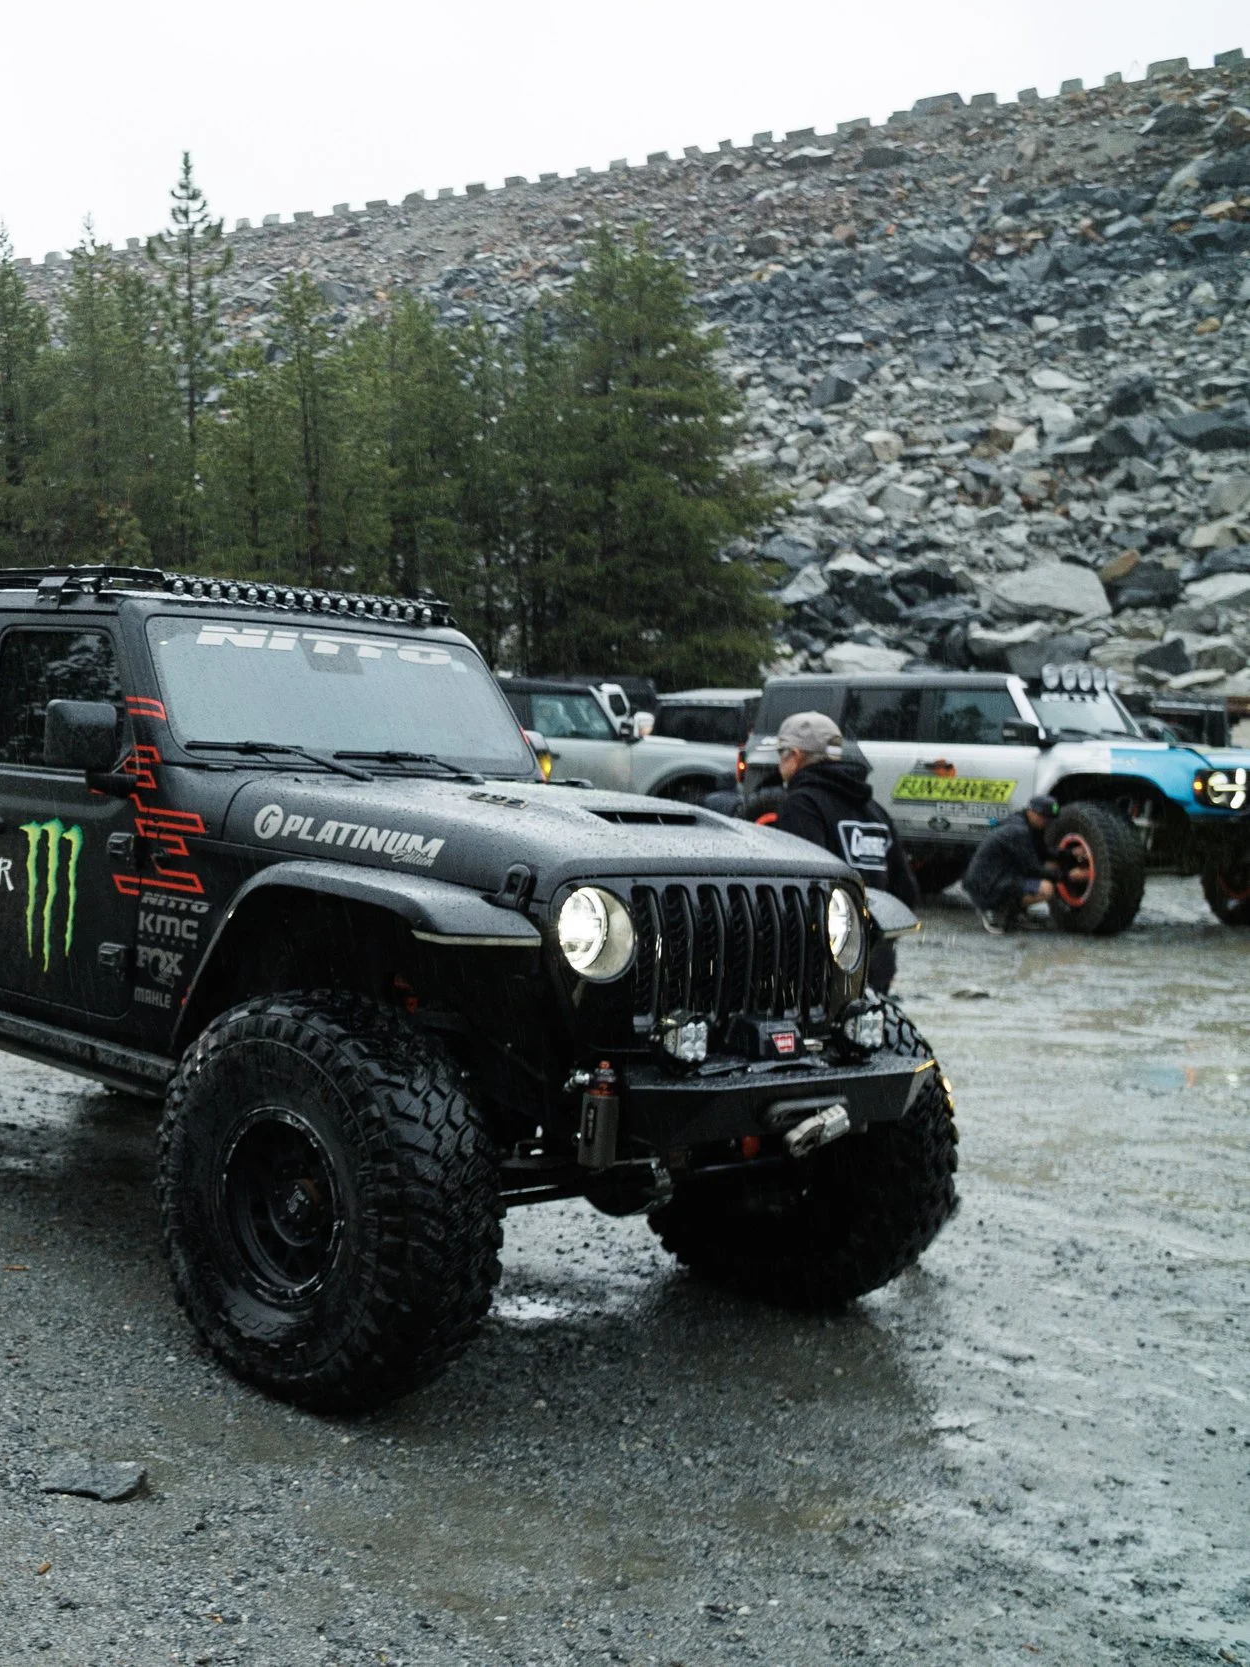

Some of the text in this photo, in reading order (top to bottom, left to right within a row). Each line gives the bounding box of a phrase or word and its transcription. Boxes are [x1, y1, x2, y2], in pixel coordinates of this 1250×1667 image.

[196, 625, 451, 666] NITTO
[281, 815, 445, 858] PLATINUM
[141, 891, 211, 913] NITTO
[138, 911, 199, 940] KMC
[136, 944, 183, 977] FOX
[134, 986, 172, 1009] MAHLE
